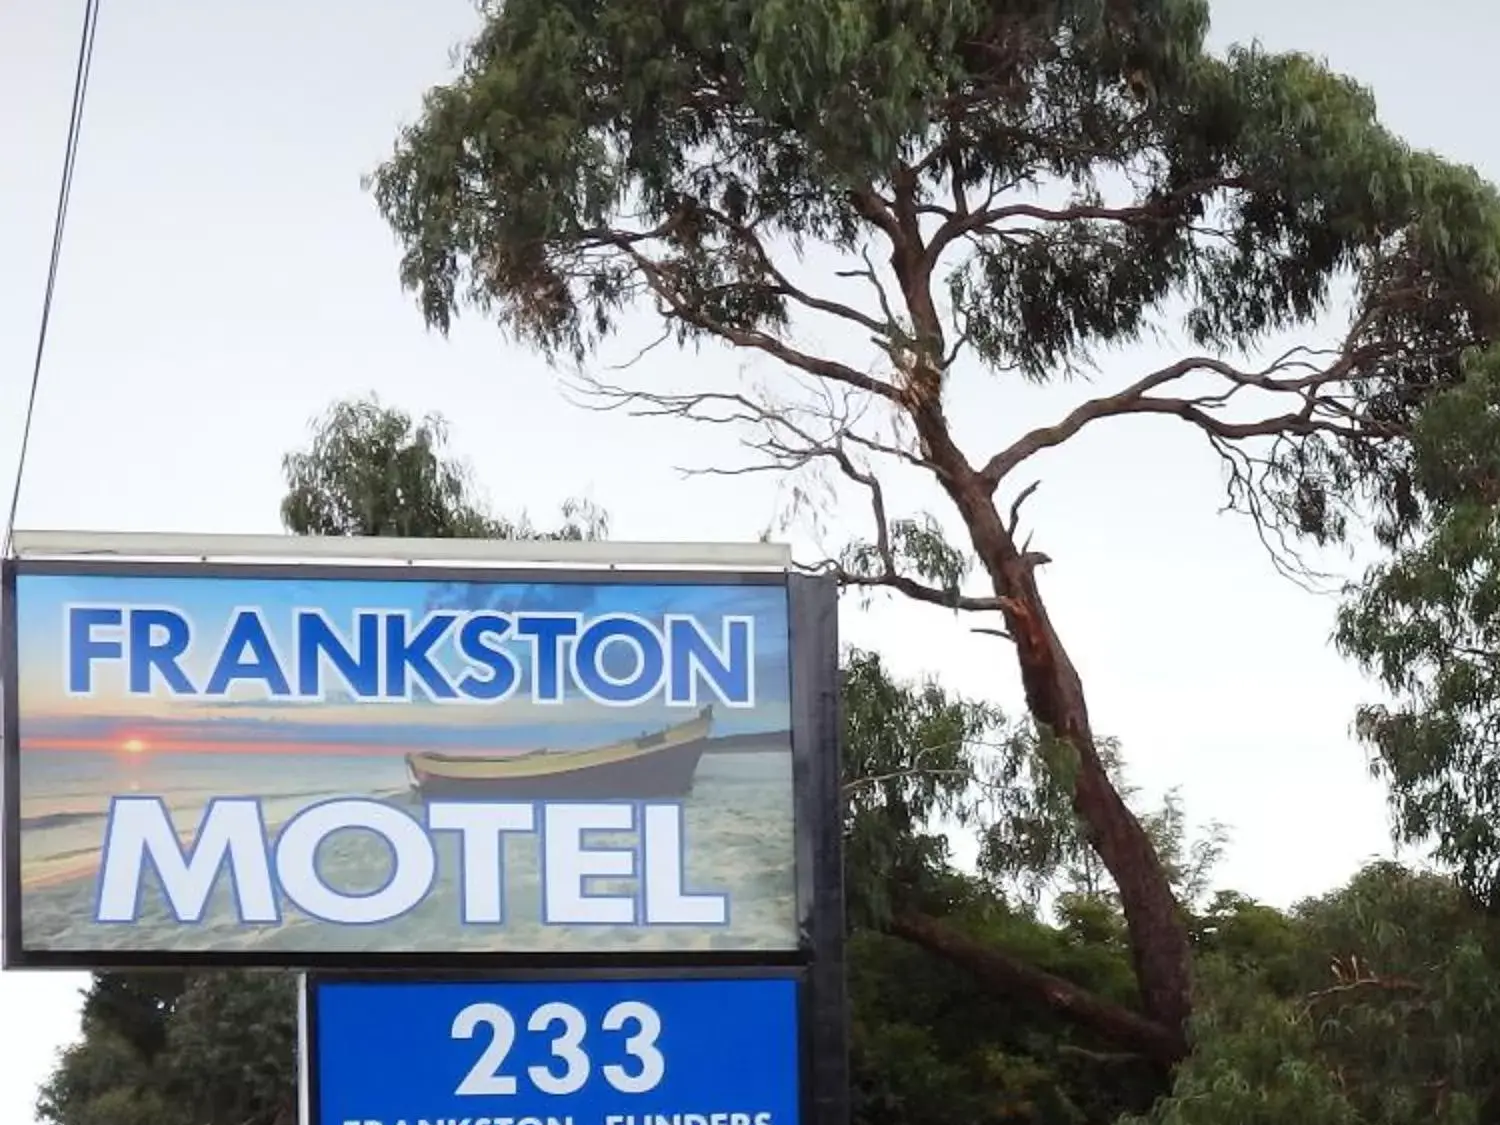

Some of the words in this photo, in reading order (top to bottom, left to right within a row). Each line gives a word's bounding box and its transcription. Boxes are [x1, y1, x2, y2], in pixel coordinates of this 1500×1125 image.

[64, 603, 757, 706] FRANKSTON
[94, 796, 730, 925] MOTEL
[450, 1001, 665, 1096] 233
